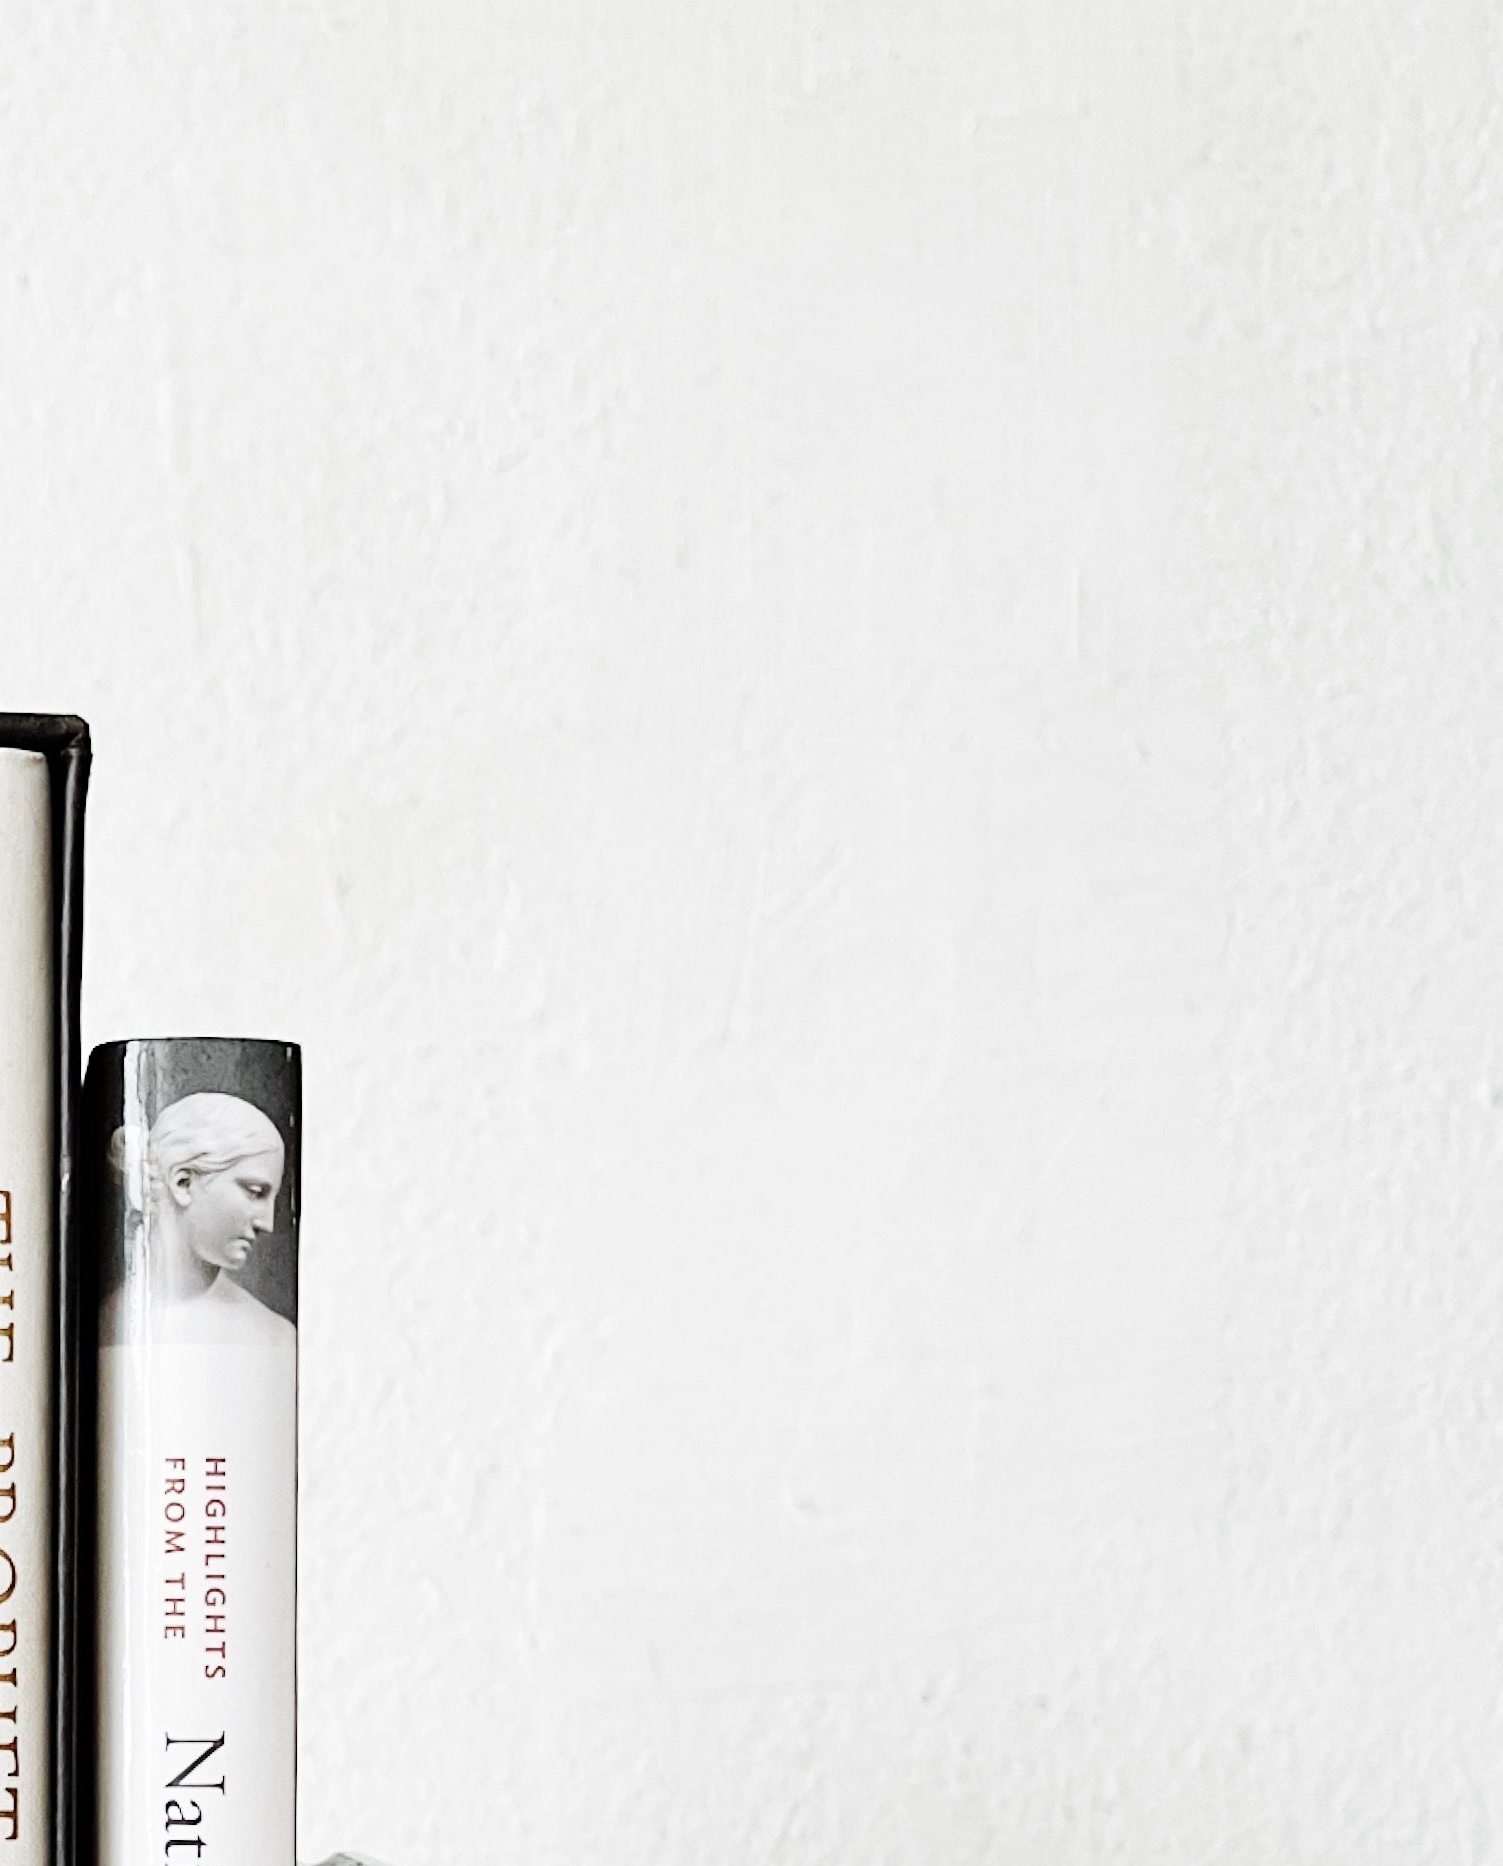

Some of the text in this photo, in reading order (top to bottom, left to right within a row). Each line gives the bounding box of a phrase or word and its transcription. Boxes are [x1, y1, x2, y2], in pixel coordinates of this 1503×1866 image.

[165, 1458, 185, 1638] FROM THE
[204, 1457, 227, 1680] HIGHLIGHTS
